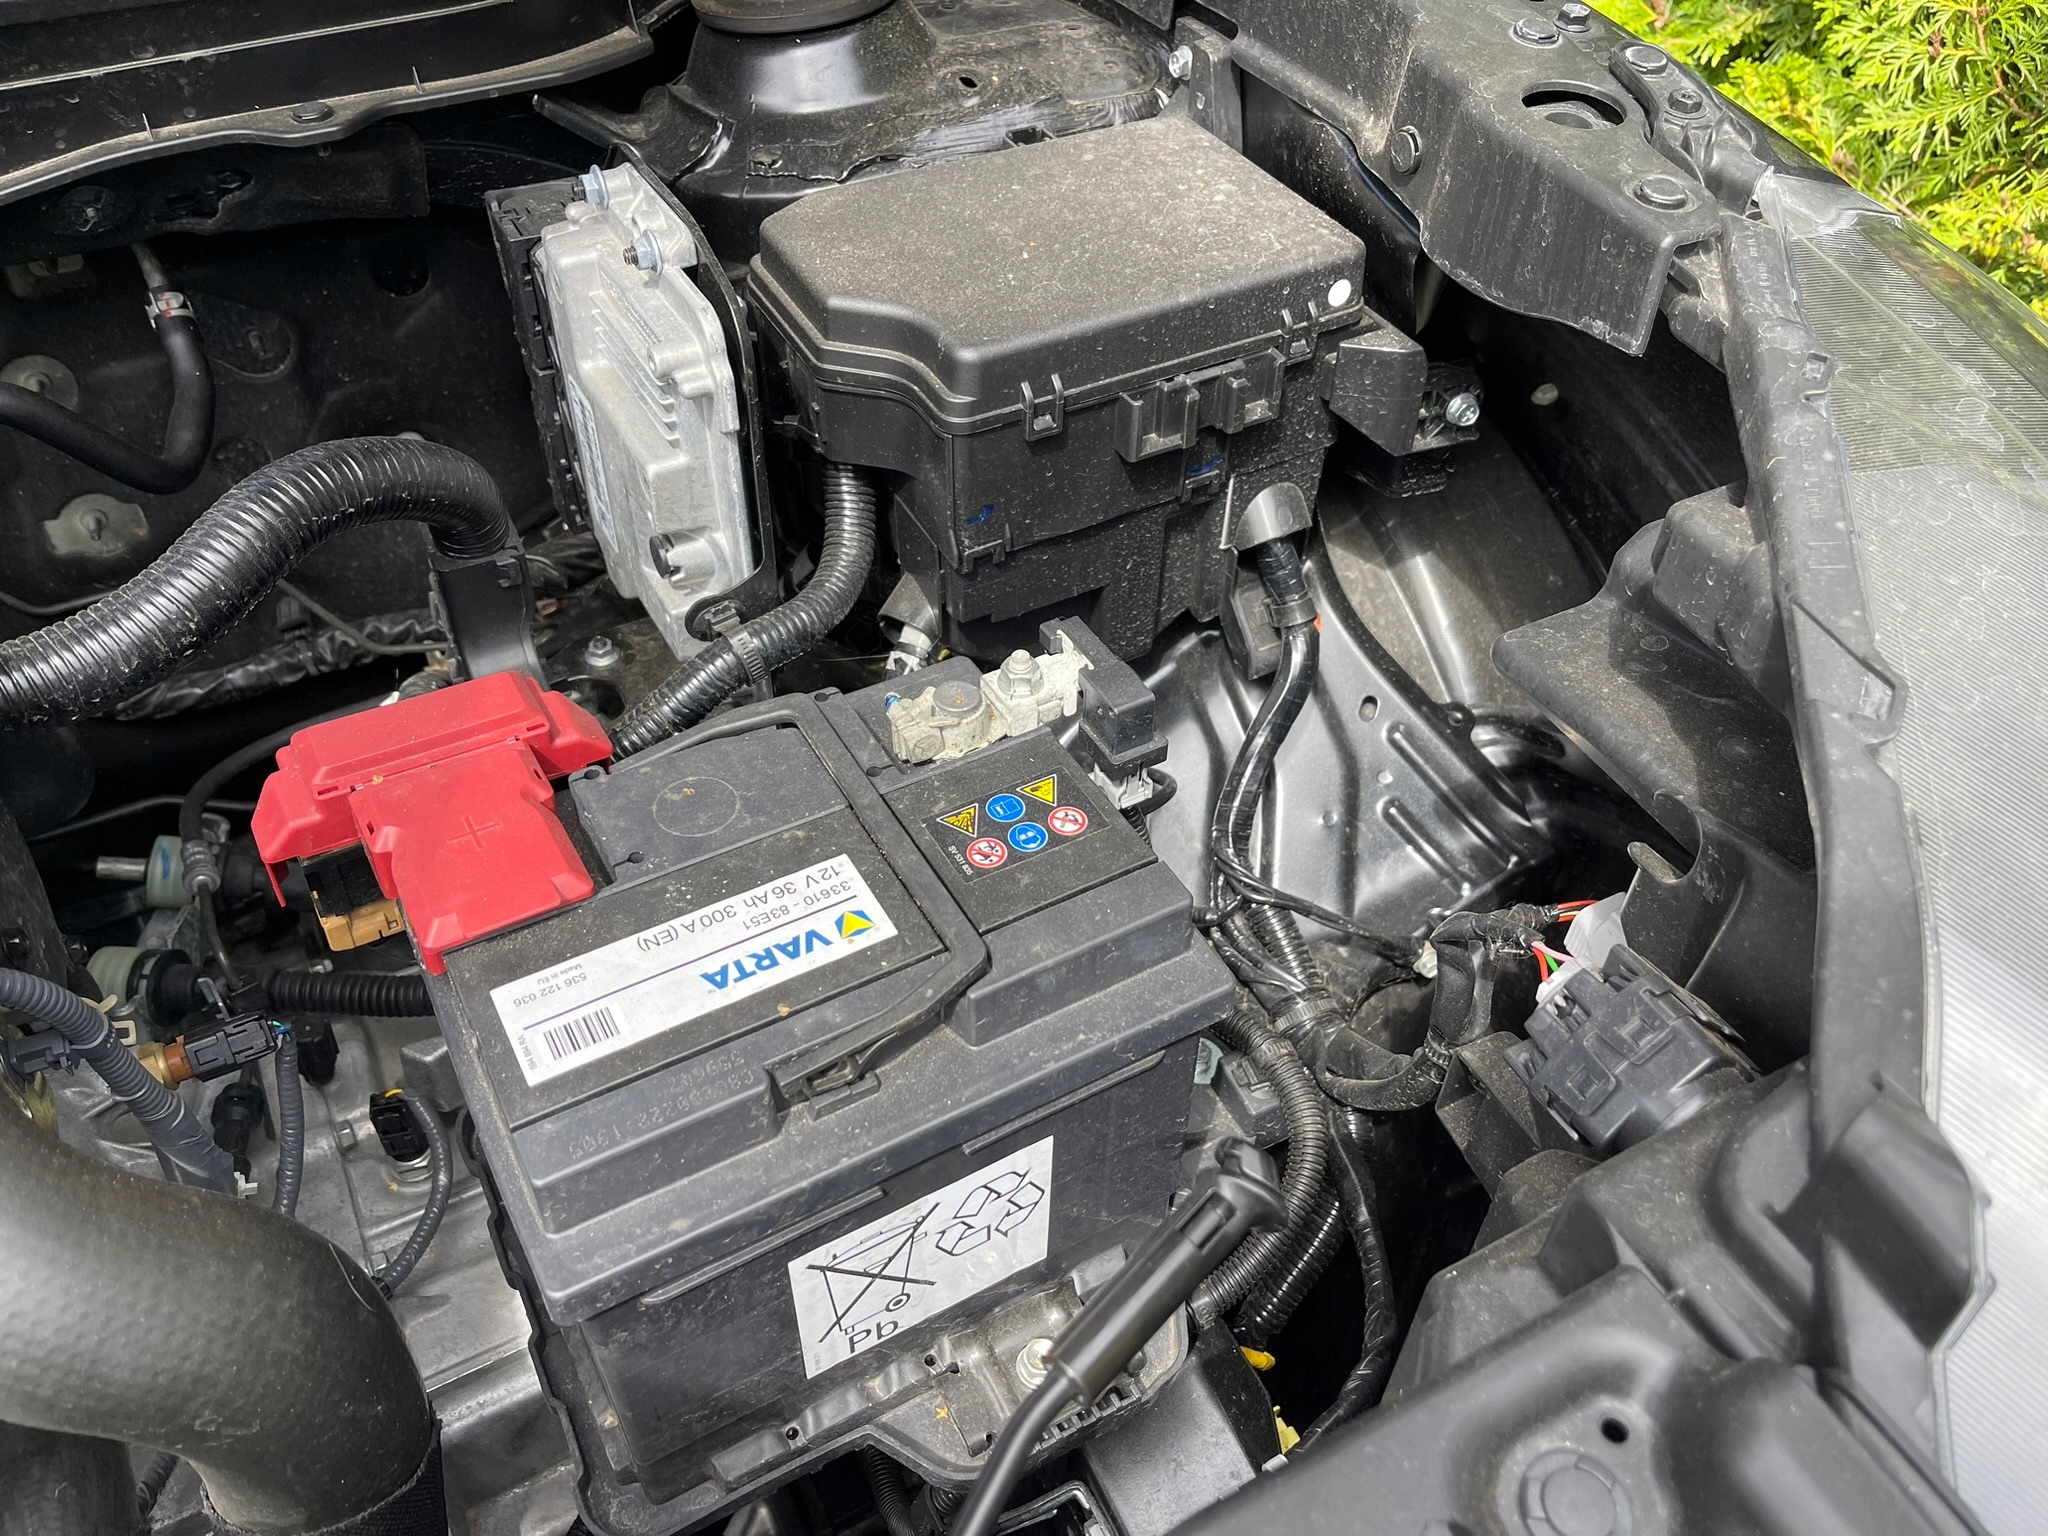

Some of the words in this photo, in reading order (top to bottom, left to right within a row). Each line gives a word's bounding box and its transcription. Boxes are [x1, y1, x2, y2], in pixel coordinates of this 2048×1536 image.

[805, 874, 820, 888] V
[817, 865, 841, 882] 12
[771, 881, 797, 899] 36
[803, 880, 851, 906] 33610
[742, 890, 769, 909] Ah
[699, 904, 737, 928] 300
[742, 904, 790, 930] 83E51
[680, 919, 696, 934] A
[636, 924, 679, 952] (EN)
[699, 928, 834, 990] VARTA
[550, 972, 559, 980] in
[560, 963, 582, 976] Made
[537, 976, 550, 986] EU
[564, 972, 587, 988] 536
[539, 983, 562, 997] 122
[513, 992, 537, 1008] 036
[849, 1320, 899, 1355] Pb
